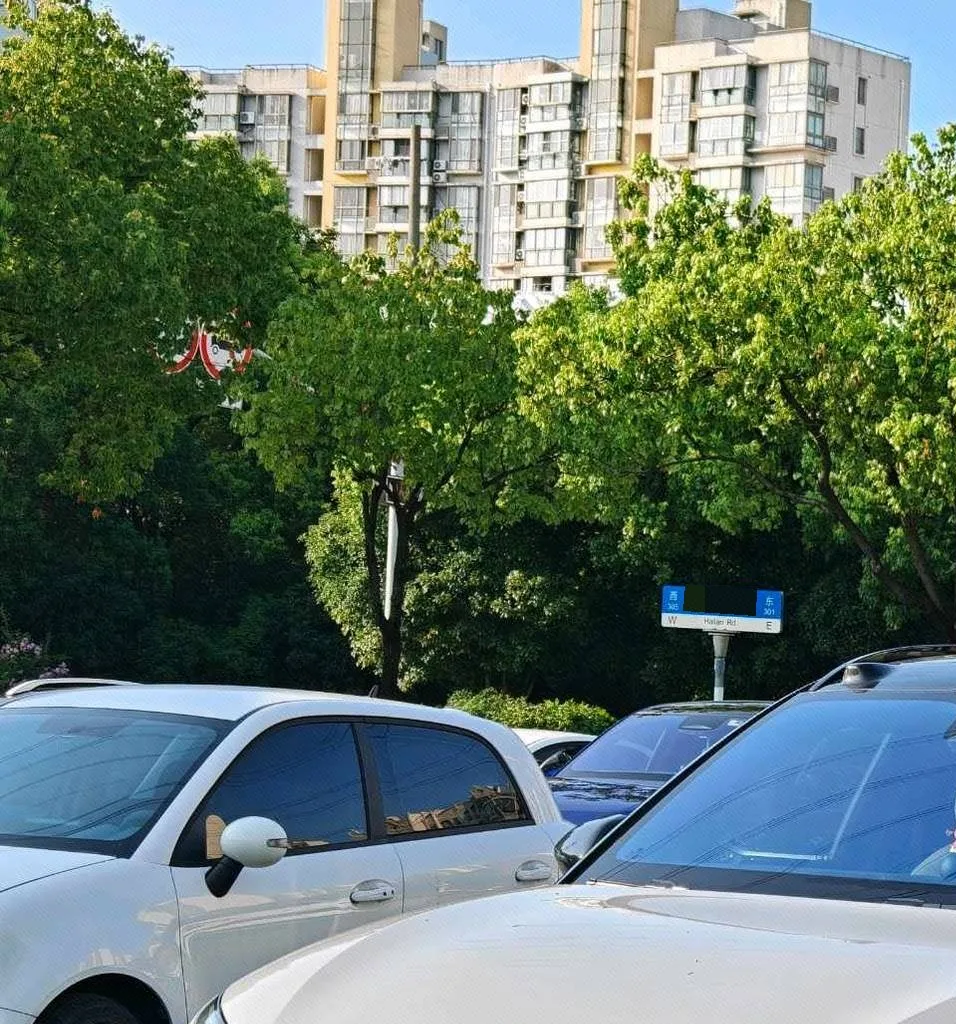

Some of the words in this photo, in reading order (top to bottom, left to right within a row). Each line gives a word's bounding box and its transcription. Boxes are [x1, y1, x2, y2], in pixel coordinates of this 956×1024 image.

[765, 596, 775, 607] 东
[668, 616, 677, 625] W
[726, 618, 736, 627] Rd
[766, 621, 773, 630] E
